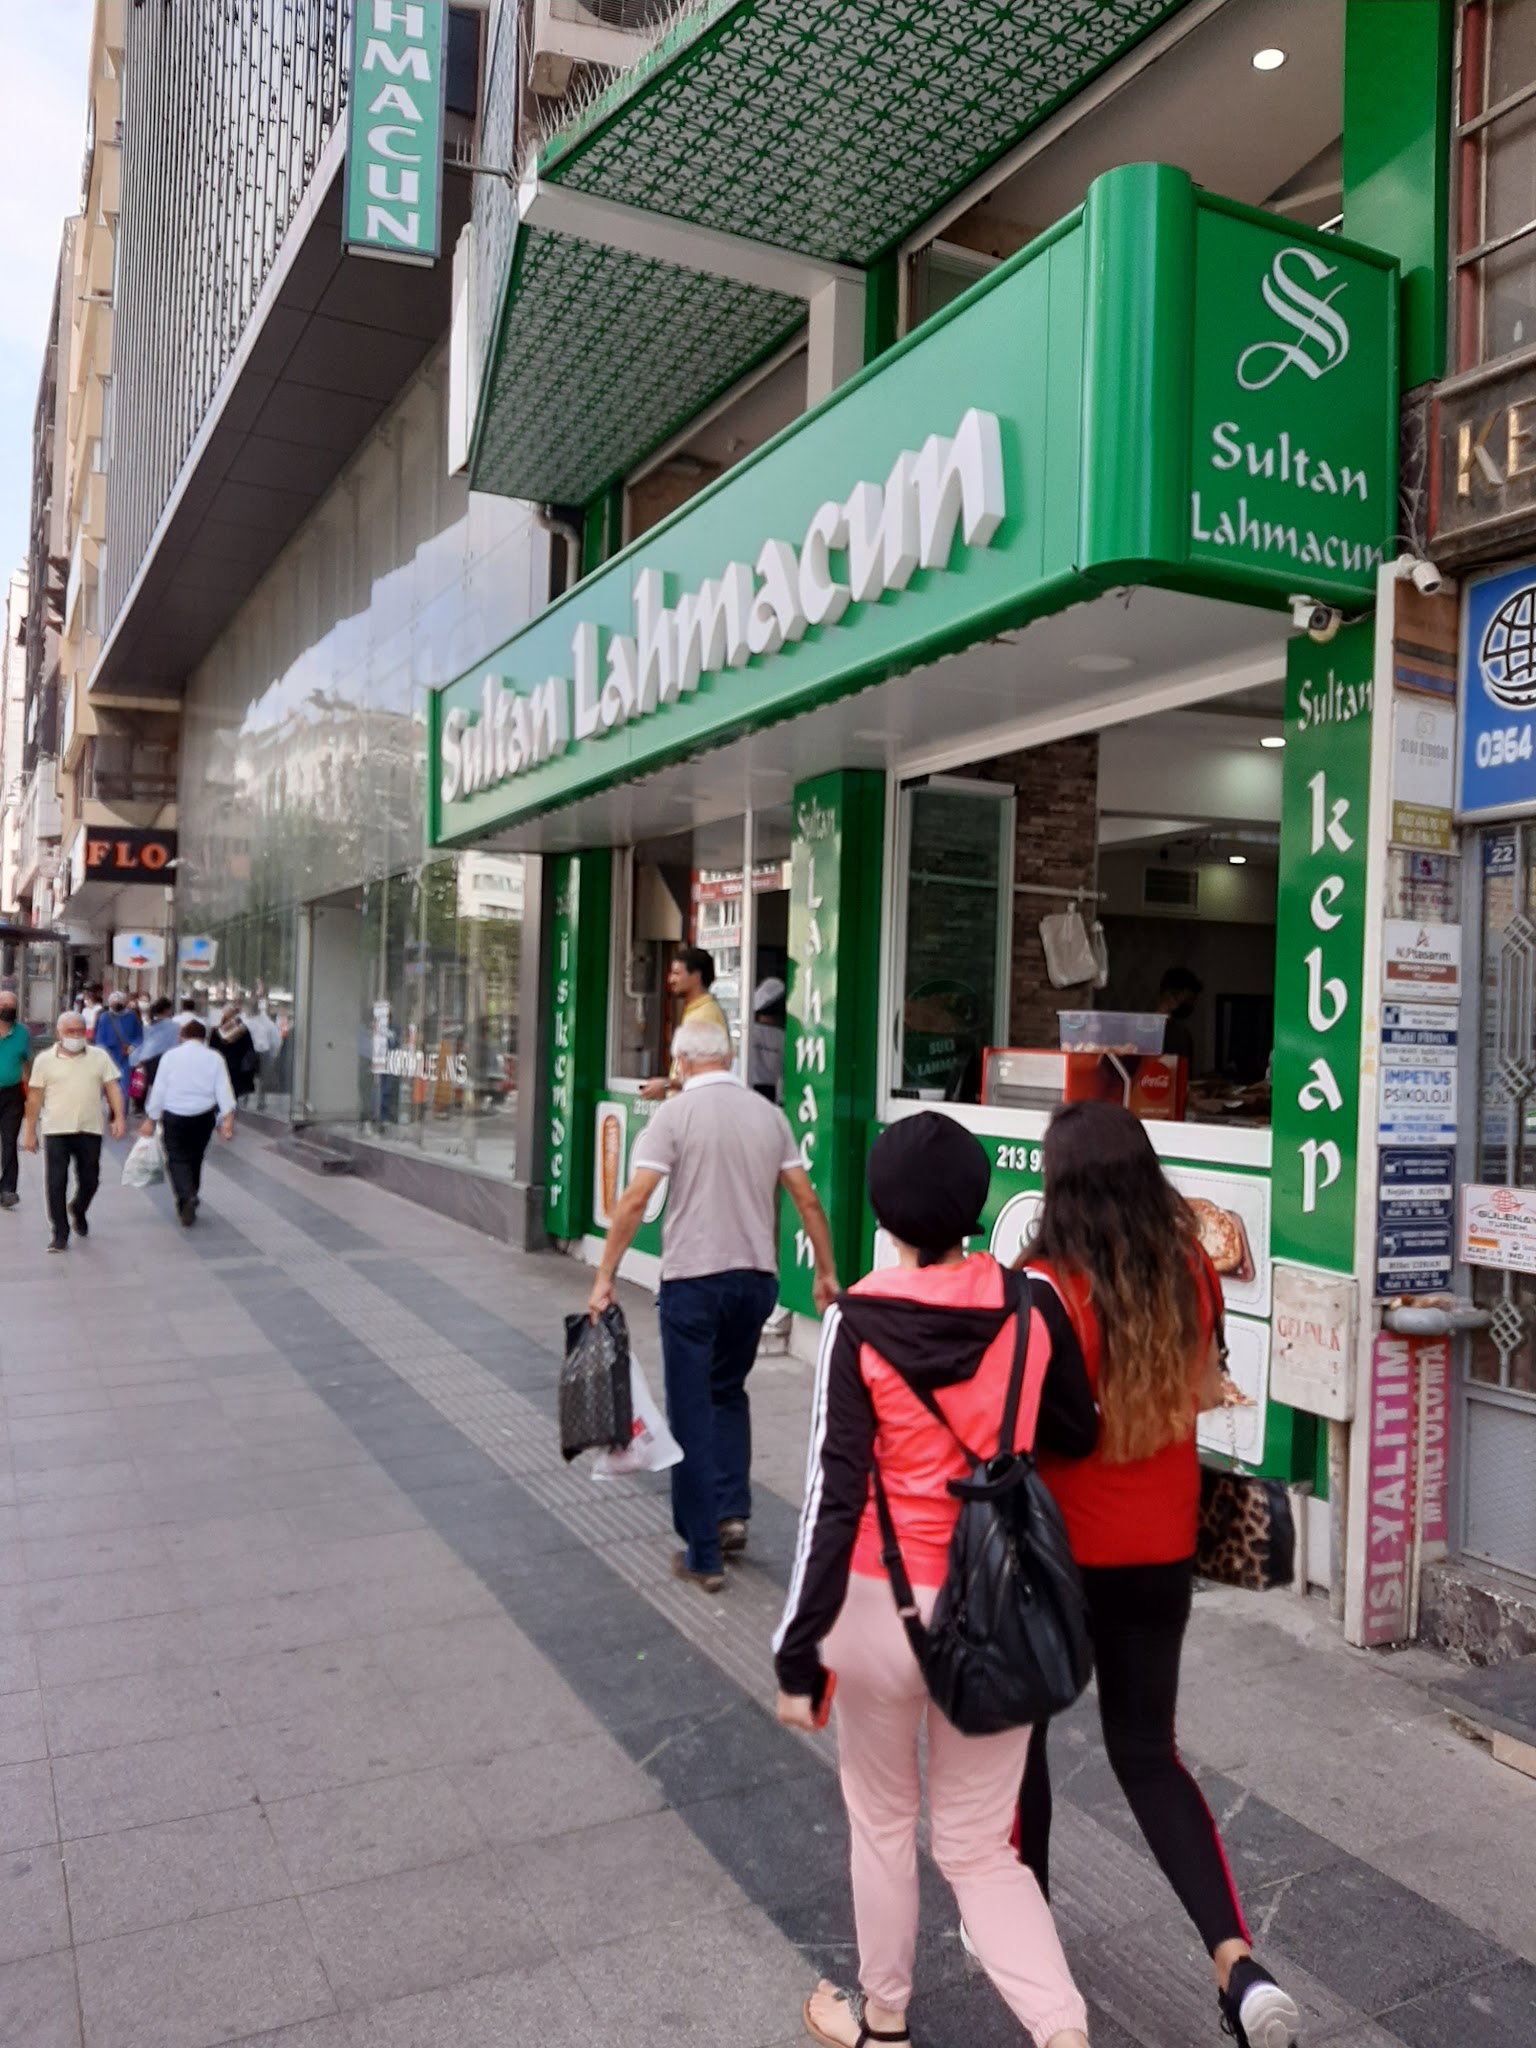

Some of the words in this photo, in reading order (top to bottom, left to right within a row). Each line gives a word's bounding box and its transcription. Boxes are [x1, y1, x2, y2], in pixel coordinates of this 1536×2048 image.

[1210, 420, 1369, 502] Sultan
[1191, 491, 1385, 572] Lahmacun
[441, 674, 569, 805] Sultan
[572, 406, 1006, 741] Lahmacun
[1297, 669, 1375, 732] Sultan
[86, 839, 168, 870] FLO
[1297, 769, 1356, 1214] kebap
[793, 857, 827, 1270] Lahmacn
[996, 1144, 1027, 1171] 213
[1029, 1148, 1046, 1174] 9
[1372, 1339, 1410, 1544] YALITIM
[1369, 1559, 1403, 1630] ISI
